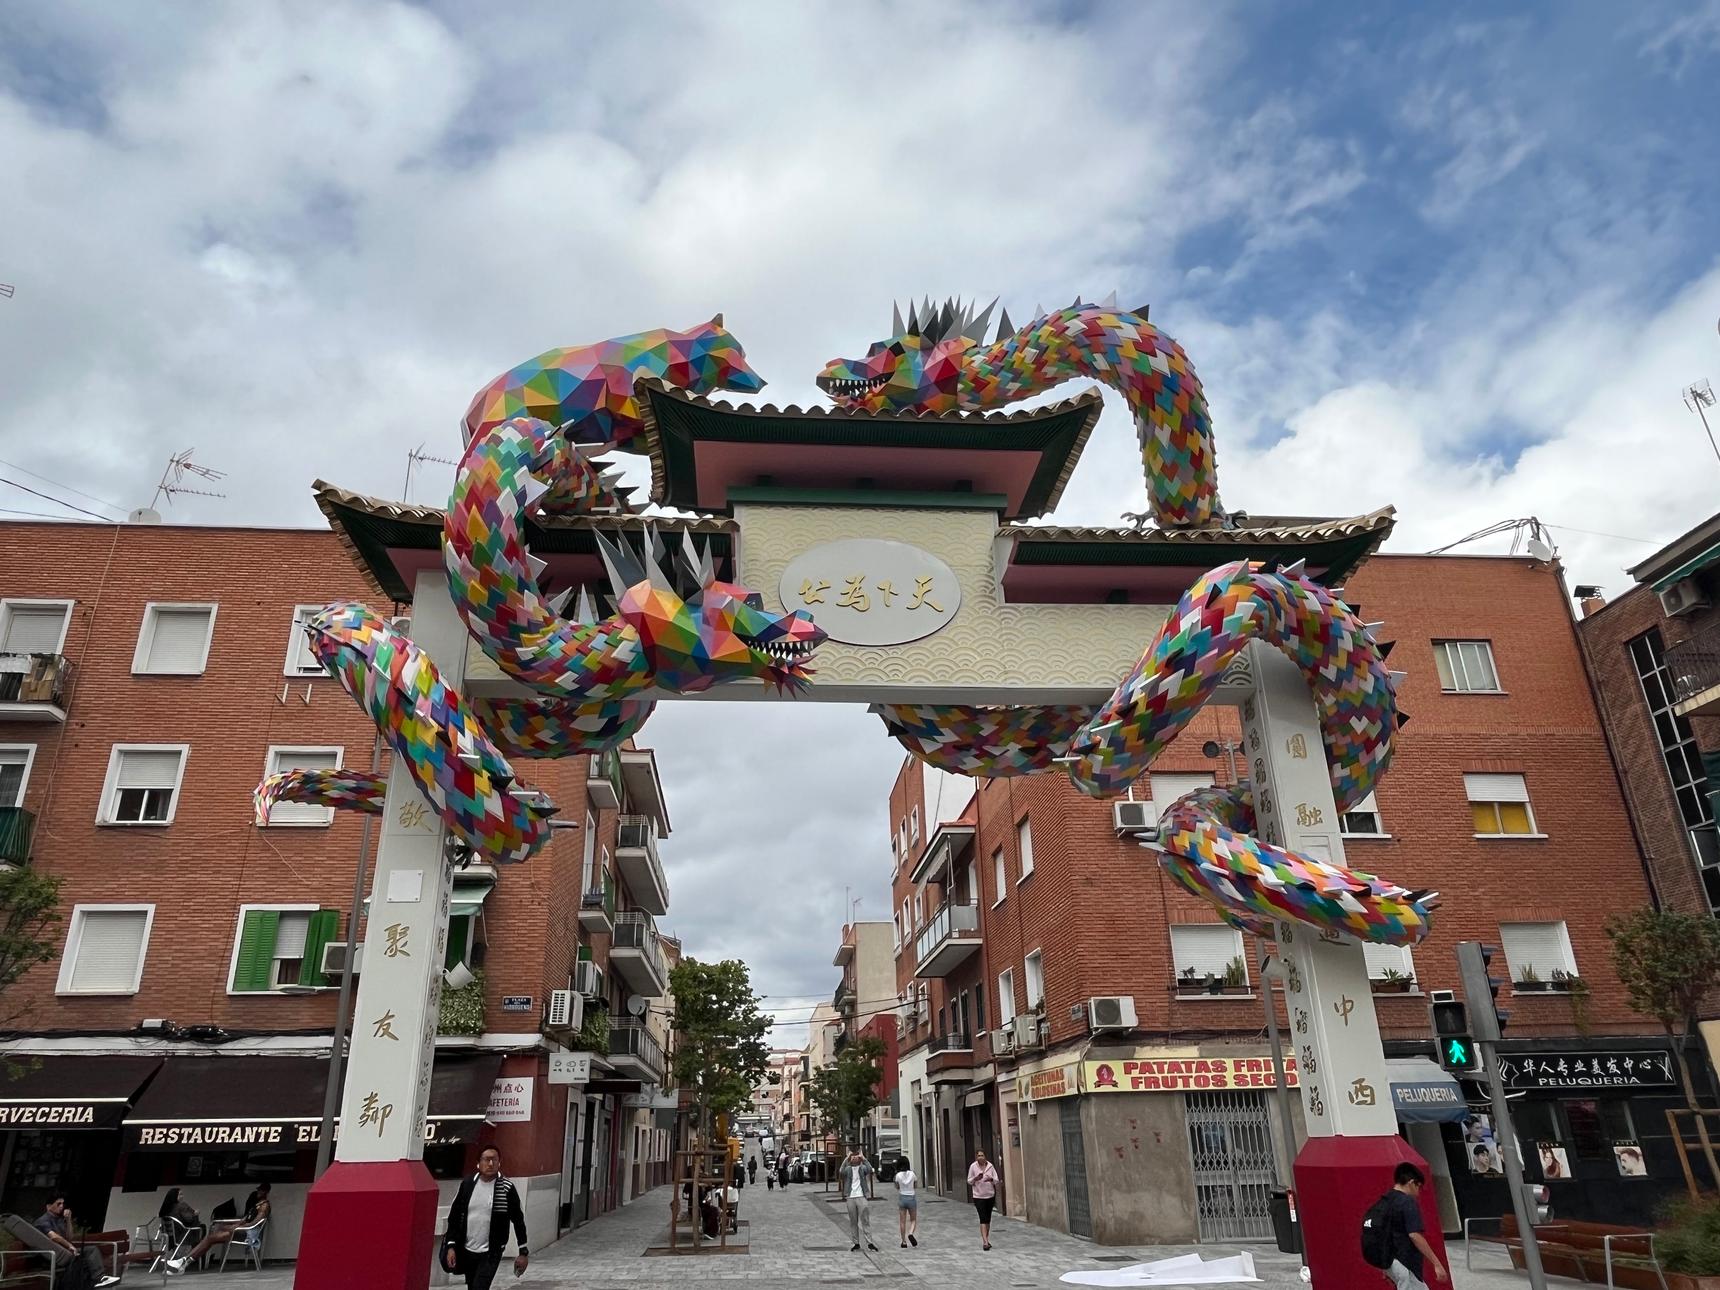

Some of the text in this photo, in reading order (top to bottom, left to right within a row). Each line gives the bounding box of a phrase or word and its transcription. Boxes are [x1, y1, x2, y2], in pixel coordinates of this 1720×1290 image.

[1123, 1058, 1297, 1075] PATATAS FRIA
[1130, 1072, 1299, 1090] FRUTOS SECO
[1537, 1076, 1641, 1086] PELUQUERIA
[1396, 1087, 1459, 1103] PELUQUERIA
[139, 1126, 283, 1145] RESTAURANTE
